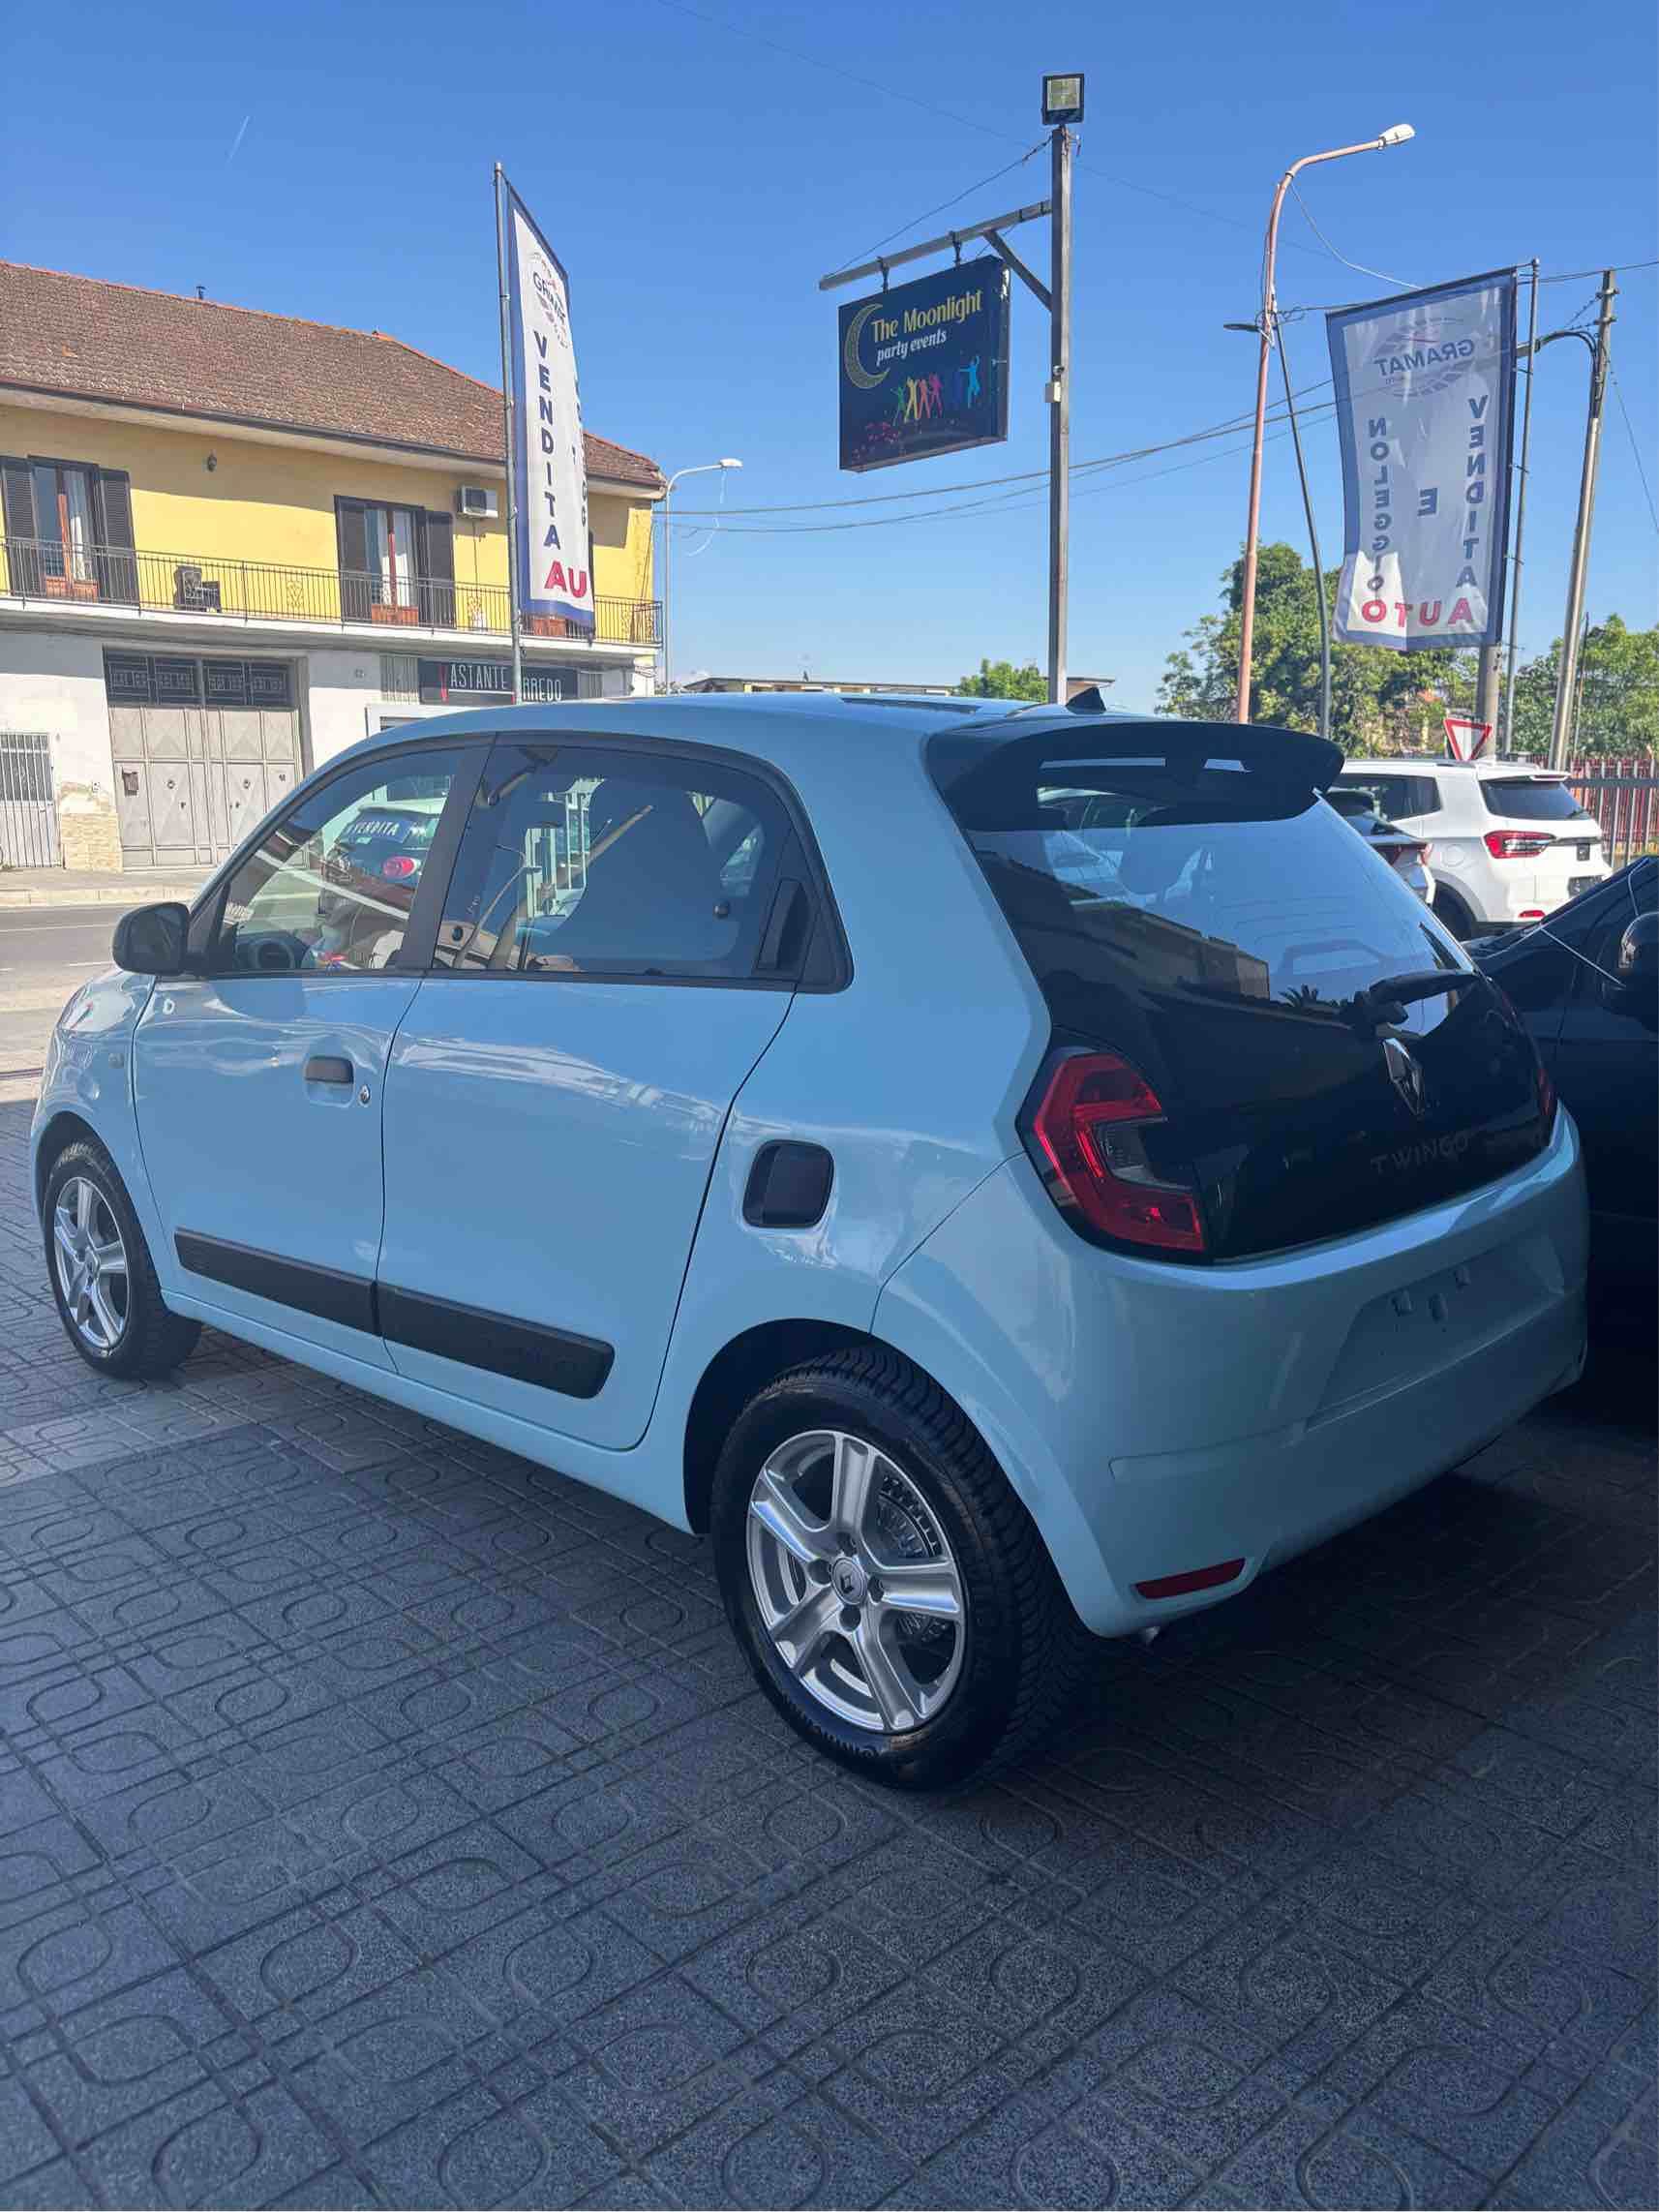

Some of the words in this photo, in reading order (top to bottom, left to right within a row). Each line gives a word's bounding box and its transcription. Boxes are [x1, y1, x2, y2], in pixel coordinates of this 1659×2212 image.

[871, 318, 898, 343] The
[904, 289, 982, 333] Moonlight
[876, 341, 908, 366] party
[910, 329, 947, 351] events
[533, 329, 560, 550] VENDITA
[511, 675, 562, 703] RREDO
[1370, 1133, 1468, 1174] TWINGO
